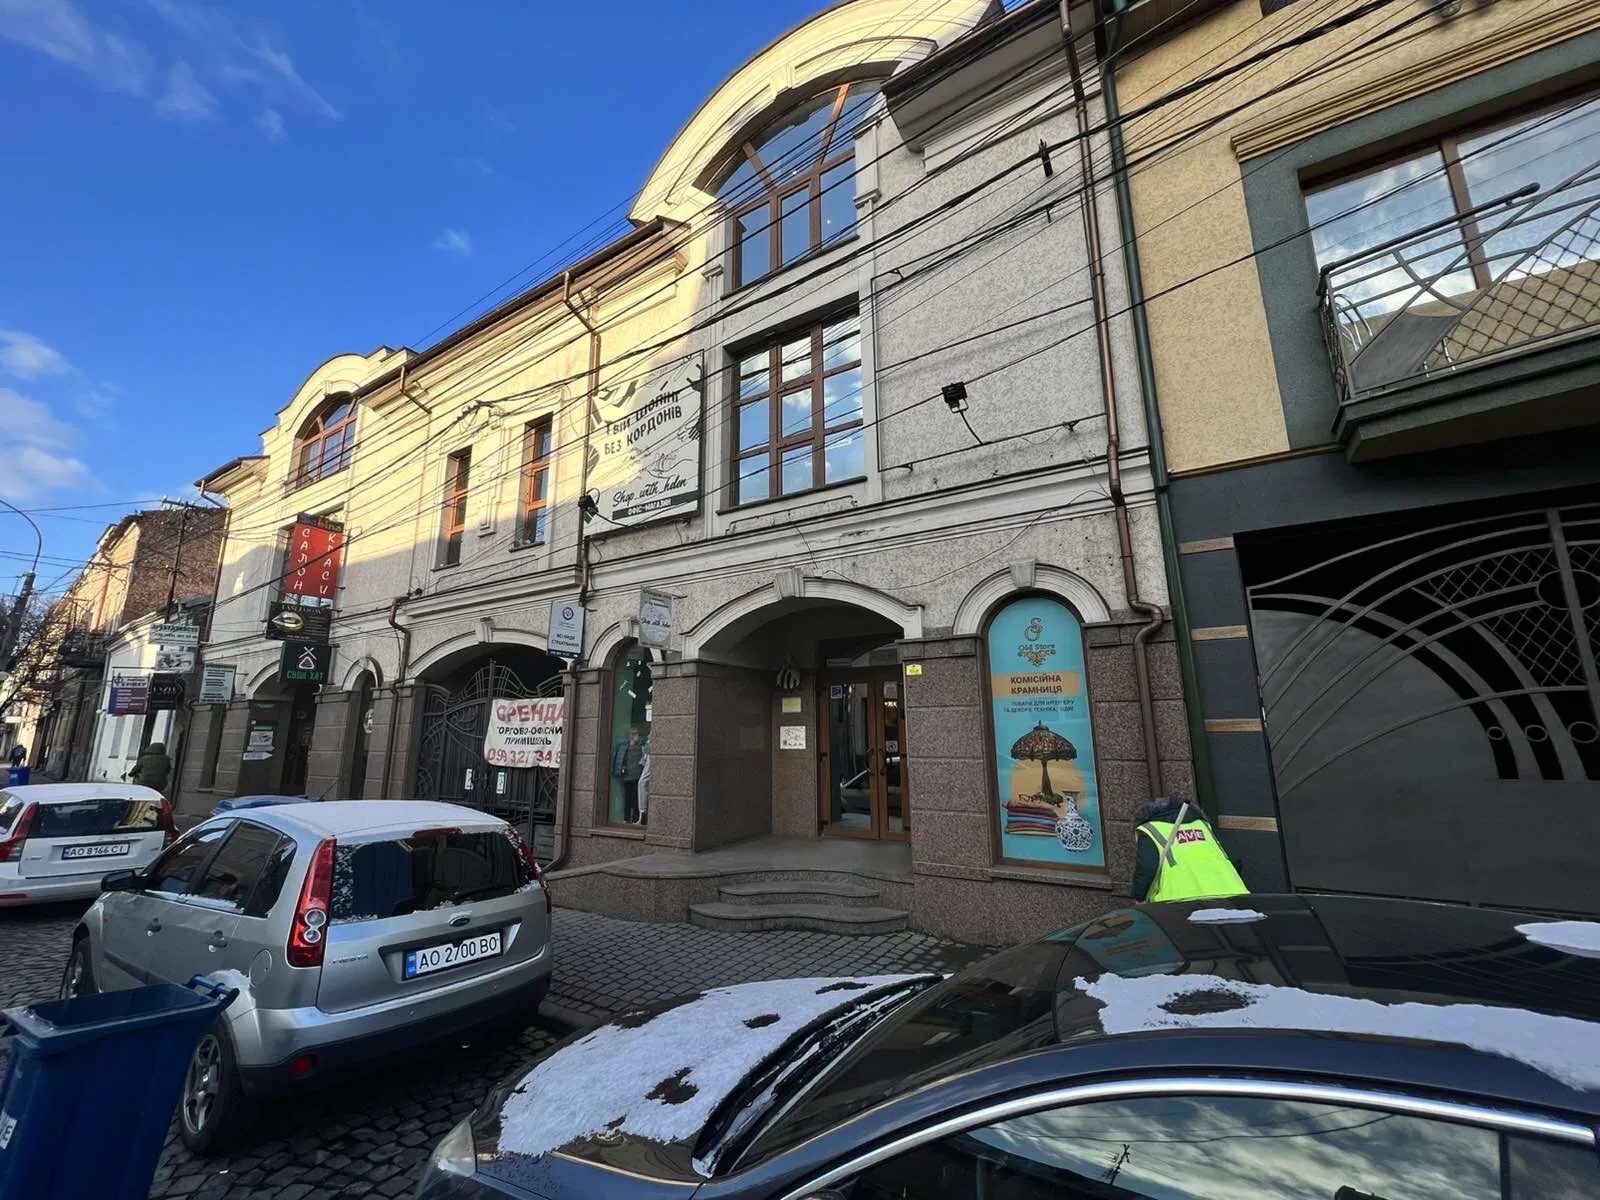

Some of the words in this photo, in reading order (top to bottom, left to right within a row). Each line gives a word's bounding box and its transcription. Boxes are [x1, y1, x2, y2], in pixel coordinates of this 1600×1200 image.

[604, 440, 622, 455] БЕЗ
[626, 405, 683, 447] КОРДОНІВ
[293, 528, 311, 591] САЛОН
[1034, 643, 1056, 651] Store
[1010, 673, 1062, 684] КОМІСІЙНА
[1011, 685, 1063, 695] КРАМНИЦЯ
[1176, 830, 1205, 843] AVE
[86, 845, 110, 856] 8166
[418, 950, 441, 970] AO
[444, 941, 477, 964] 2700
[479, 936, 498, 955] BO
